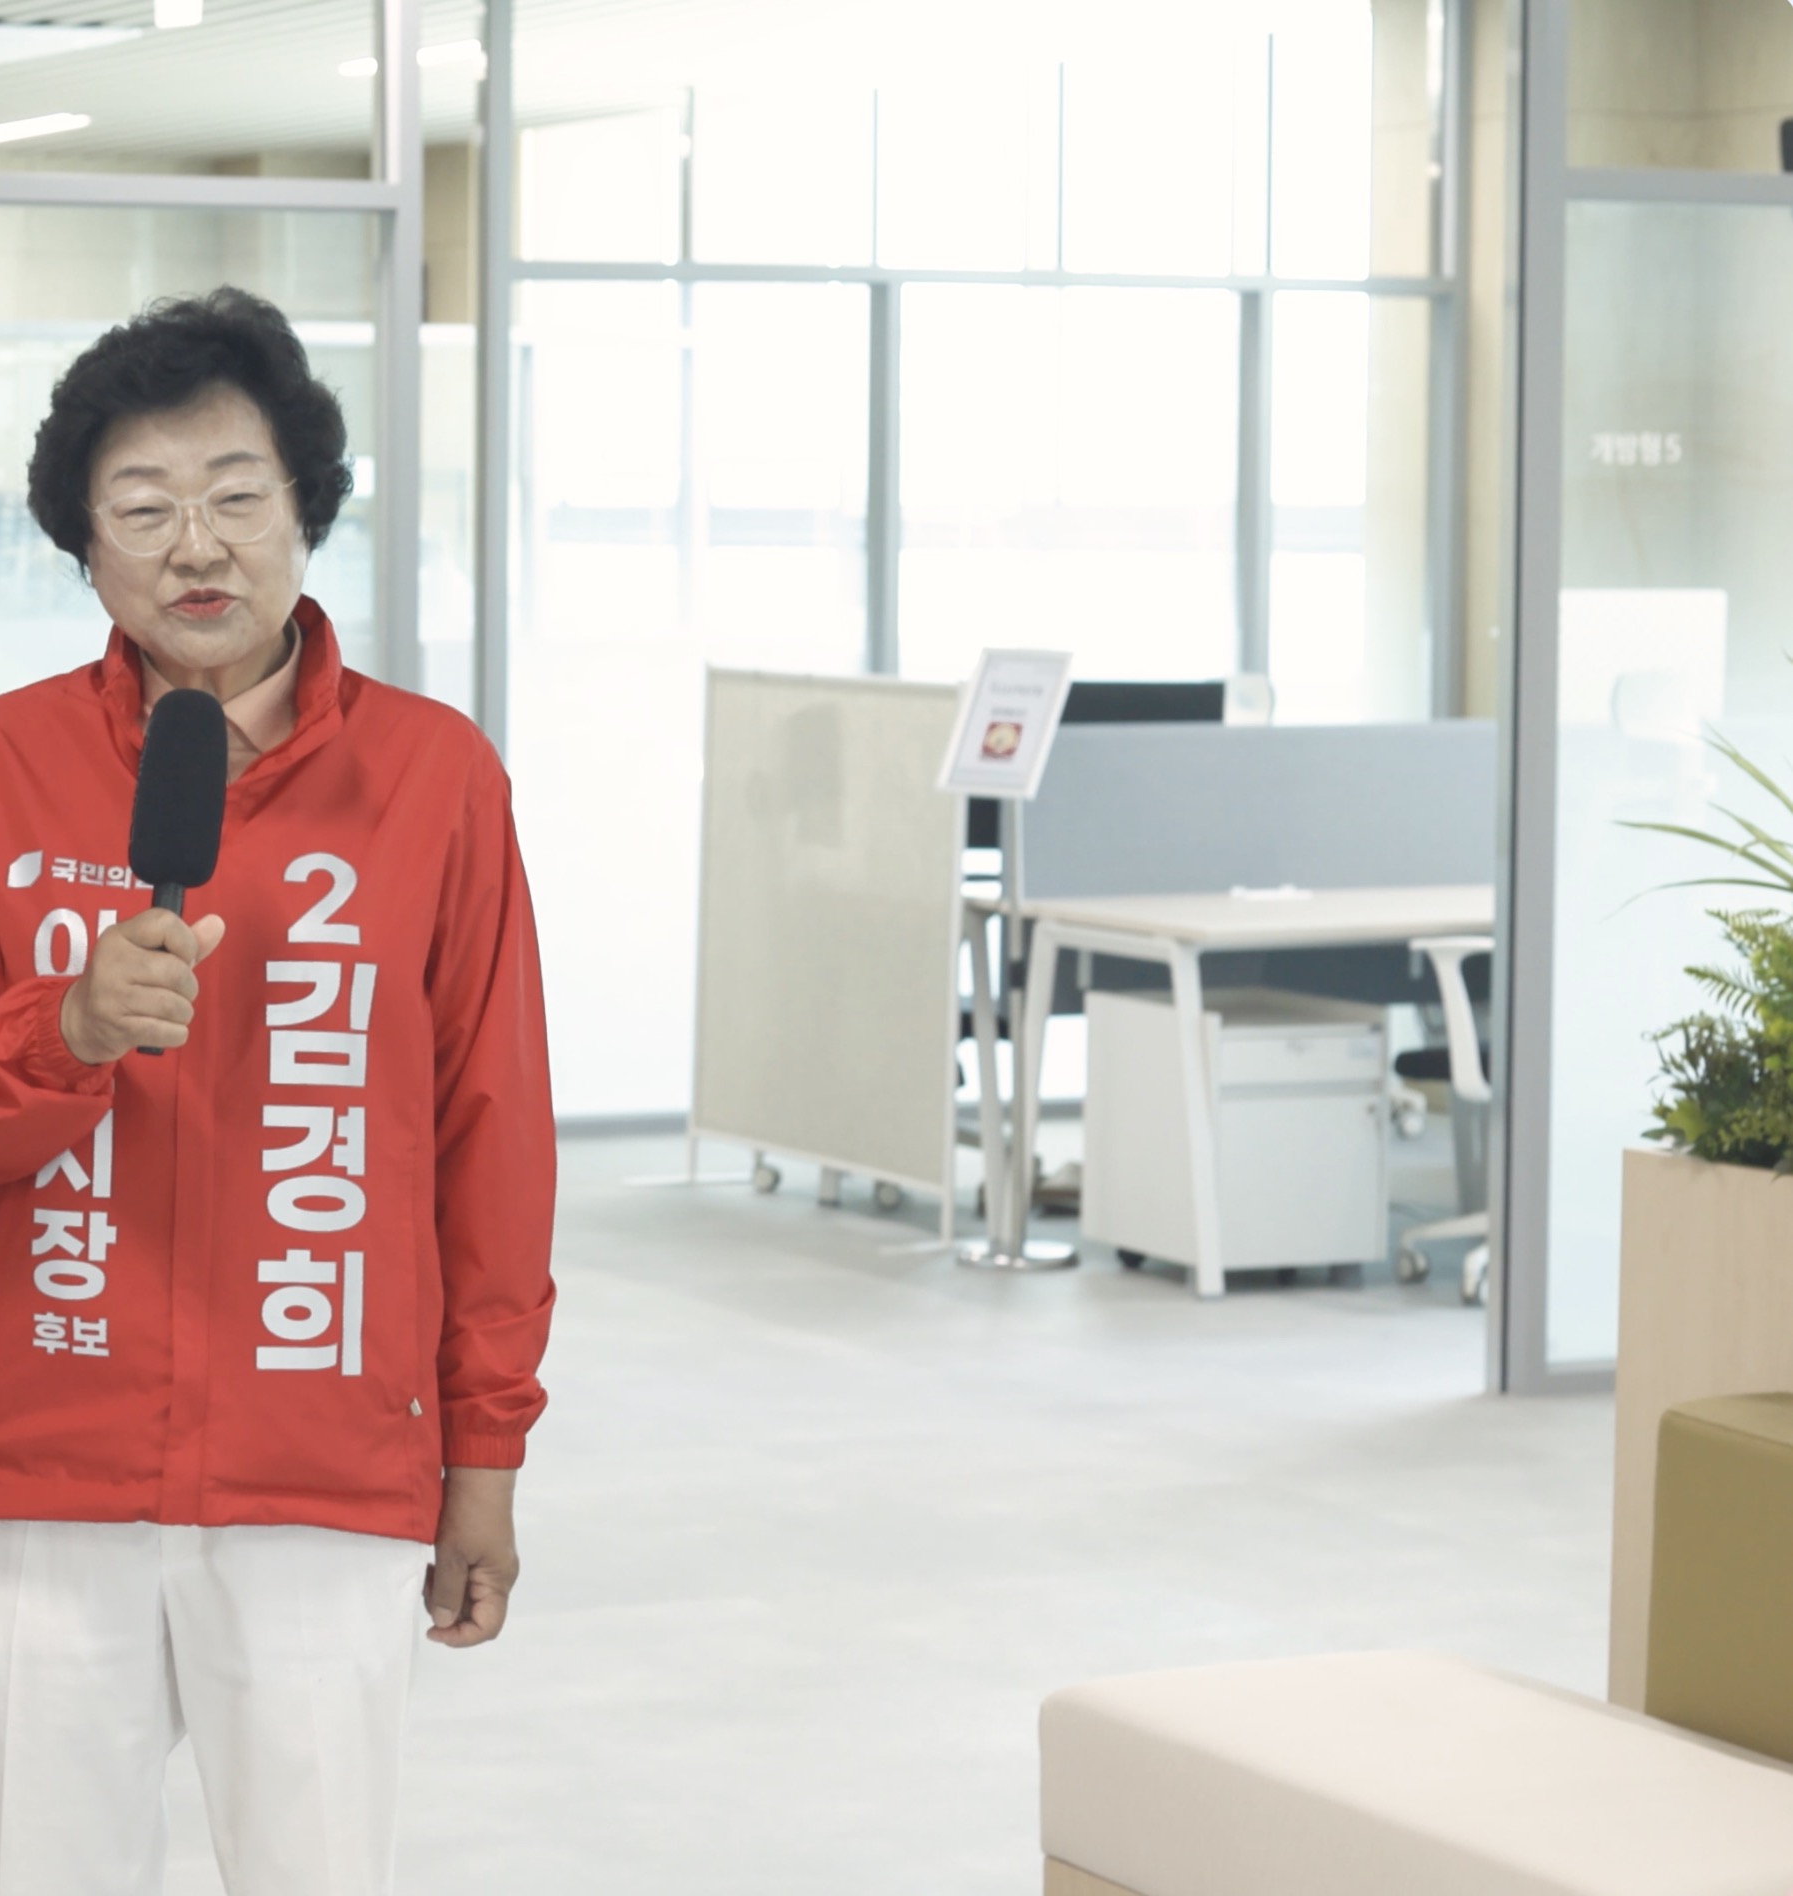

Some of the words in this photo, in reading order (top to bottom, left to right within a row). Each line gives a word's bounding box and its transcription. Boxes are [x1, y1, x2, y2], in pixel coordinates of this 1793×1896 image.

[51, 857, 154, 890] 국민의
[283, 852, 360, 945] 2
[32, 908, 117, 1300] 이시장
[256, 961, 377, 1376] 김경희
[33, 1312, 110, 1357] 후보
